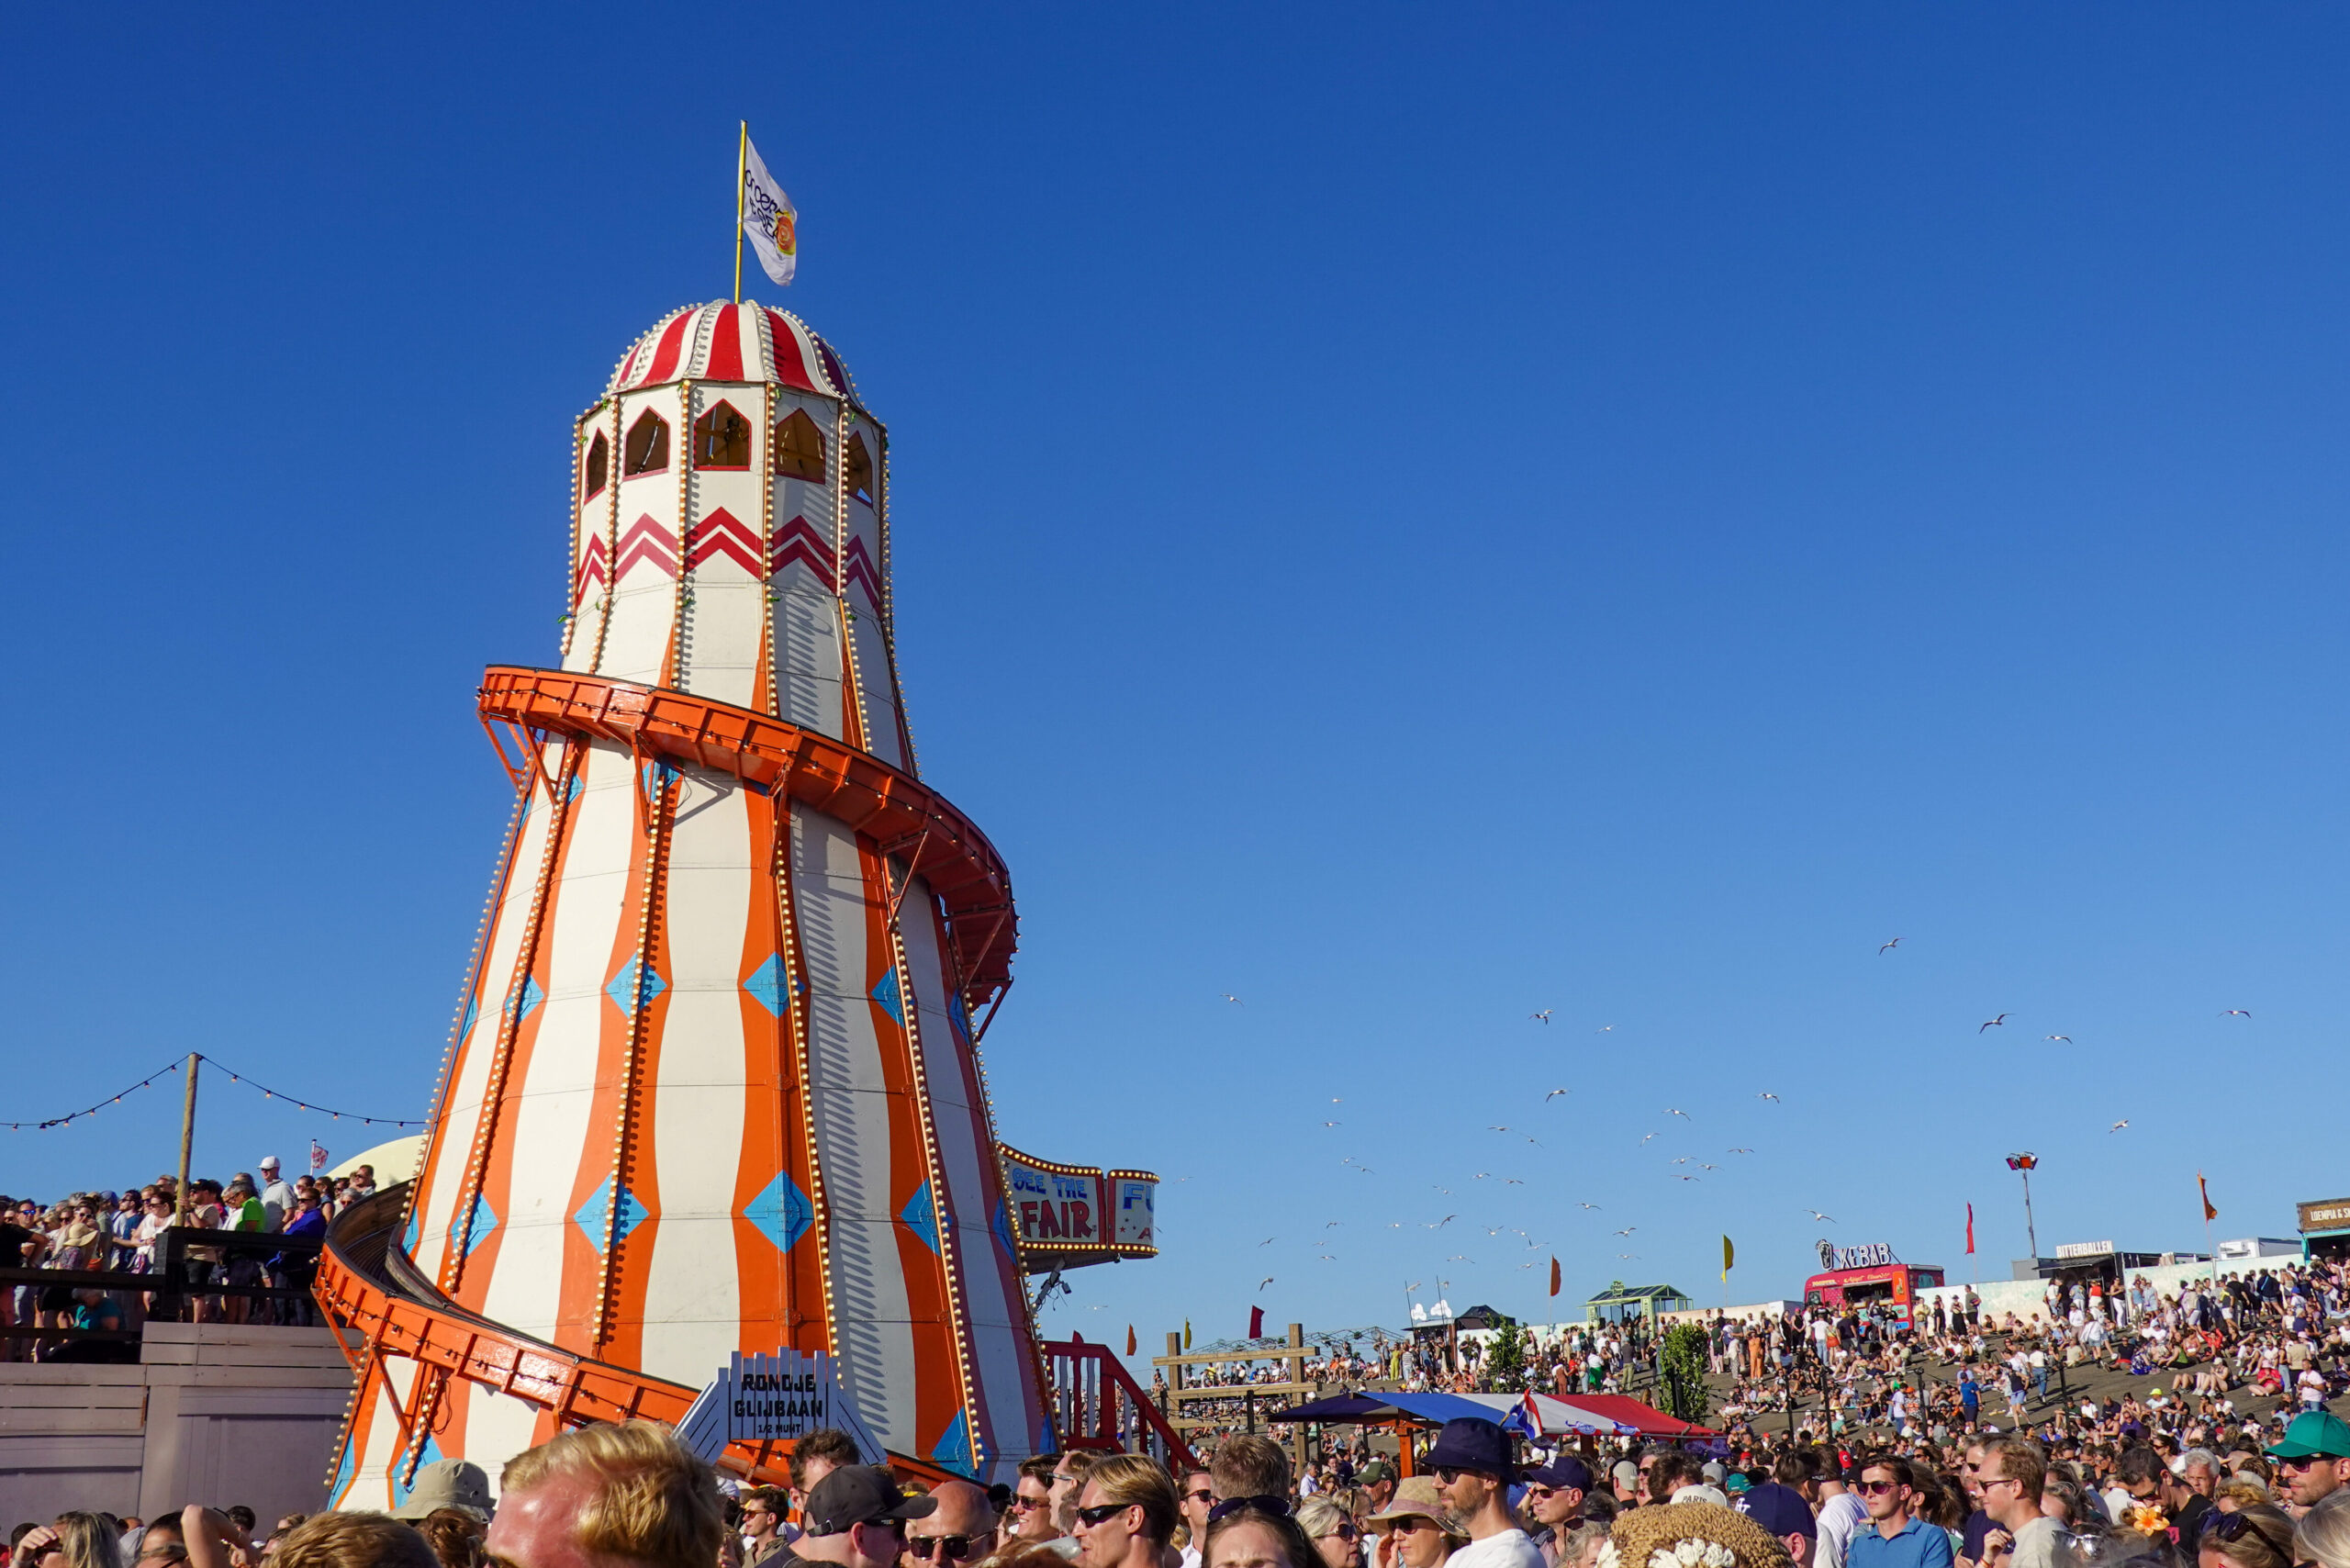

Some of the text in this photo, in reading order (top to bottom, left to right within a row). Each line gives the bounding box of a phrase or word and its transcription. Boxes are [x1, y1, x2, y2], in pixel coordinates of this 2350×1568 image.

[1013, 1168, 1087, 1199] SEE THE
[1020, 1200, 1093, 1238] FAIR
[2311, 1209, 2337, 1221] LOEMPIA
[1839, 1243, 1891, 1269] KEBAB
[2056, 1240, 2113, 1259] BITTERBALLEN
[743, 1374, 816, 1392] RONDJE
[734, 1400, 822, 1417] GLIJBAAN
[757, 1424, 800, 1433] 1/2 MUNT
